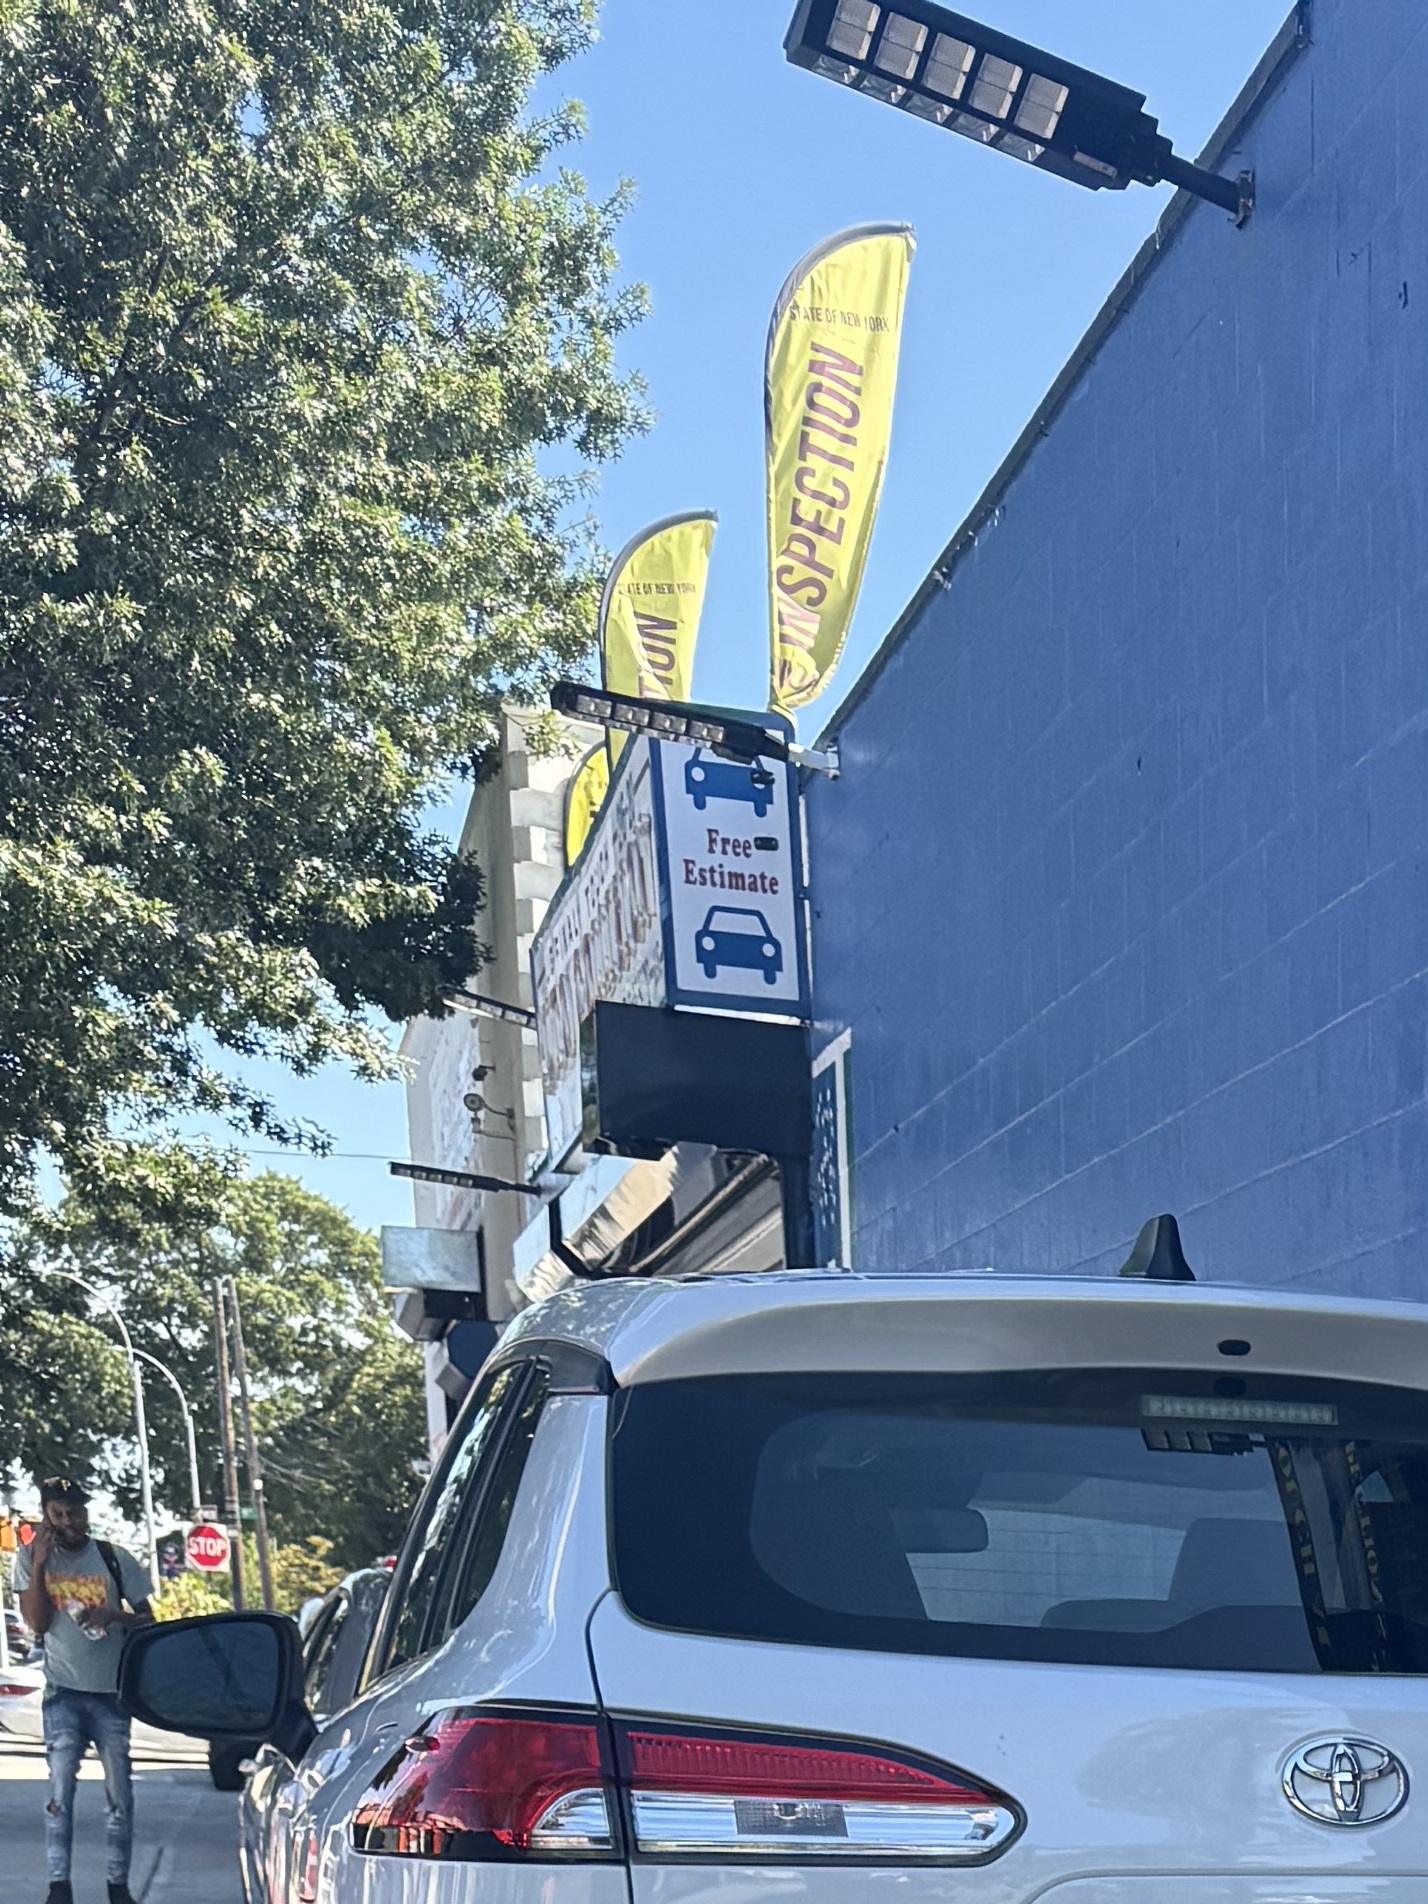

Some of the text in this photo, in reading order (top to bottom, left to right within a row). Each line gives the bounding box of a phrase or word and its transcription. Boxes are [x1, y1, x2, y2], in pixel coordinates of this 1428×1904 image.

[706, 828, 752, 858] Free
[683, 858, 779, 895] Estimate
[188, 1536, 227, 1557] STOP
